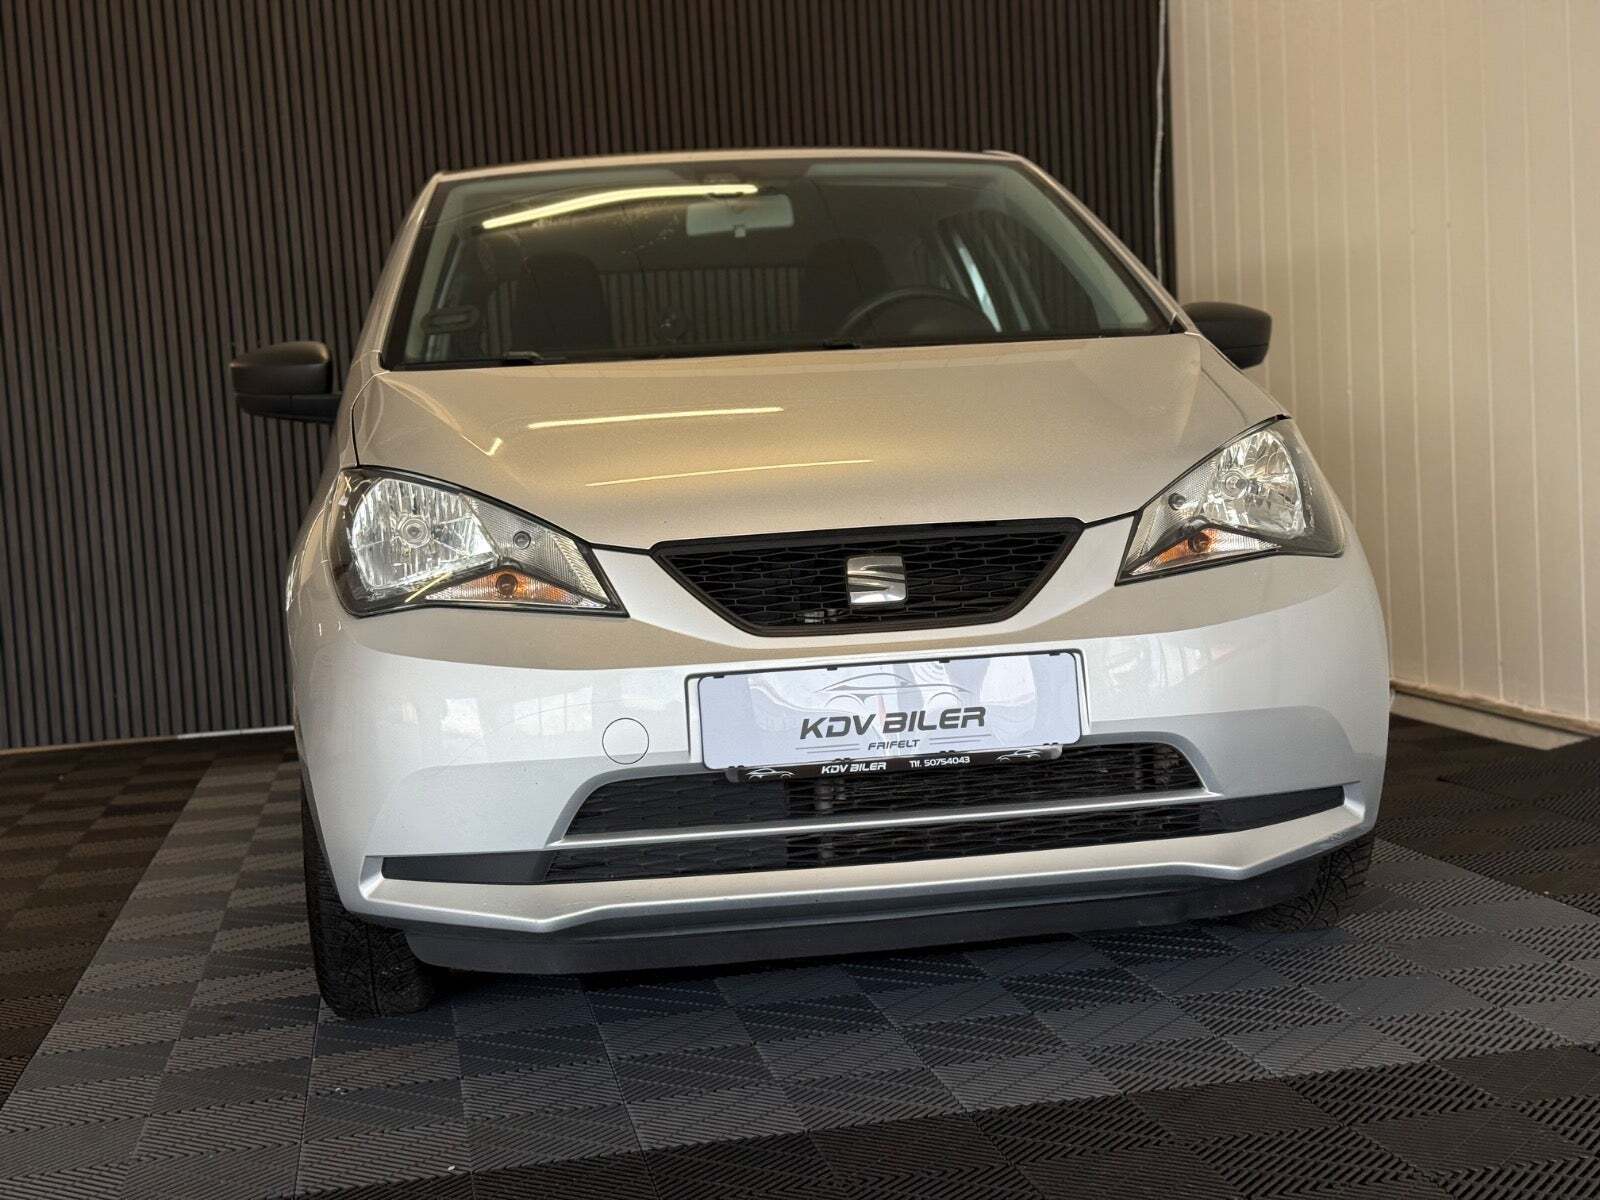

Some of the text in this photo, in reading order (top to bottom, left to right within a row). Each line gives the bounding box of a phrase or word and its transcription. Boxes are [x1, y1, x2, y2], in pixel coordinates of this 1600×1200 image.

[800, 706, 986, 740] KDV BILER
[868, 739, 921, 751] FRIFELT
[821, 761, 887, 775] KDV BILER
[924, 756, 971, 768] 50754043
